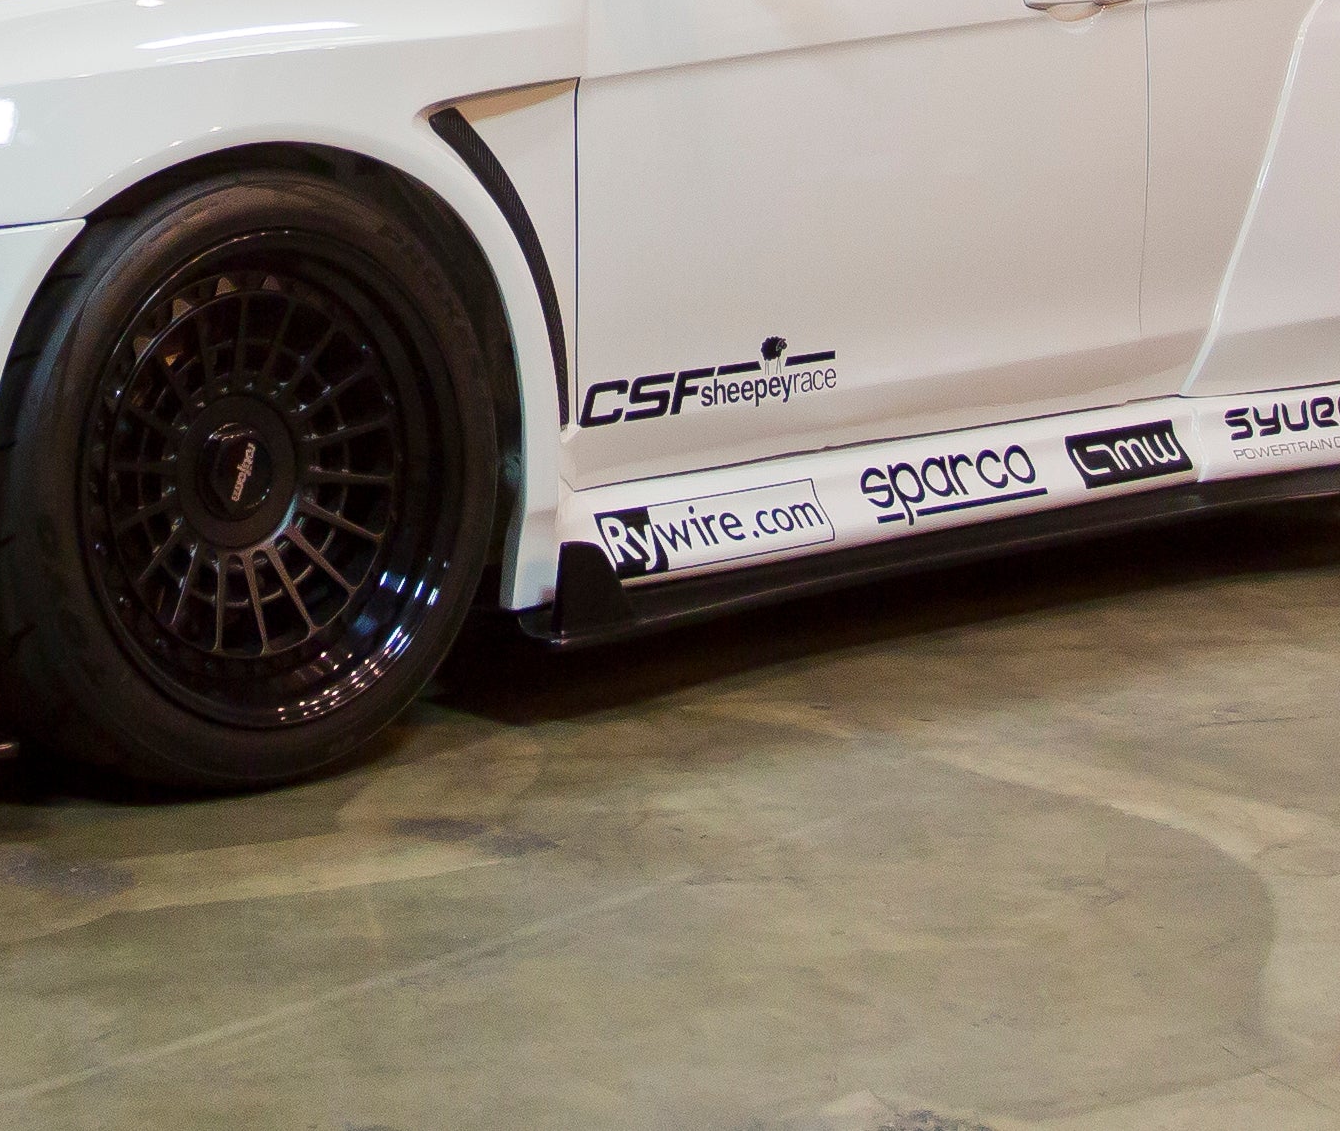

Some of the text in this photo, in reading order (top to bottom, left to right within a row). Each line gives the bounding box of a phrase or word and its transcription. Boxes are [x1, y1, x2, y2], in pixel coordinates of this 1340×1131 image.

[580, 366, 837, 428] CSF sheepeyrace
[1233, 437, 1333, 460] POWERTRAIN
[860, 444, 1037, 525] sparco
[600, 501, 825, 571] Rywire.com
